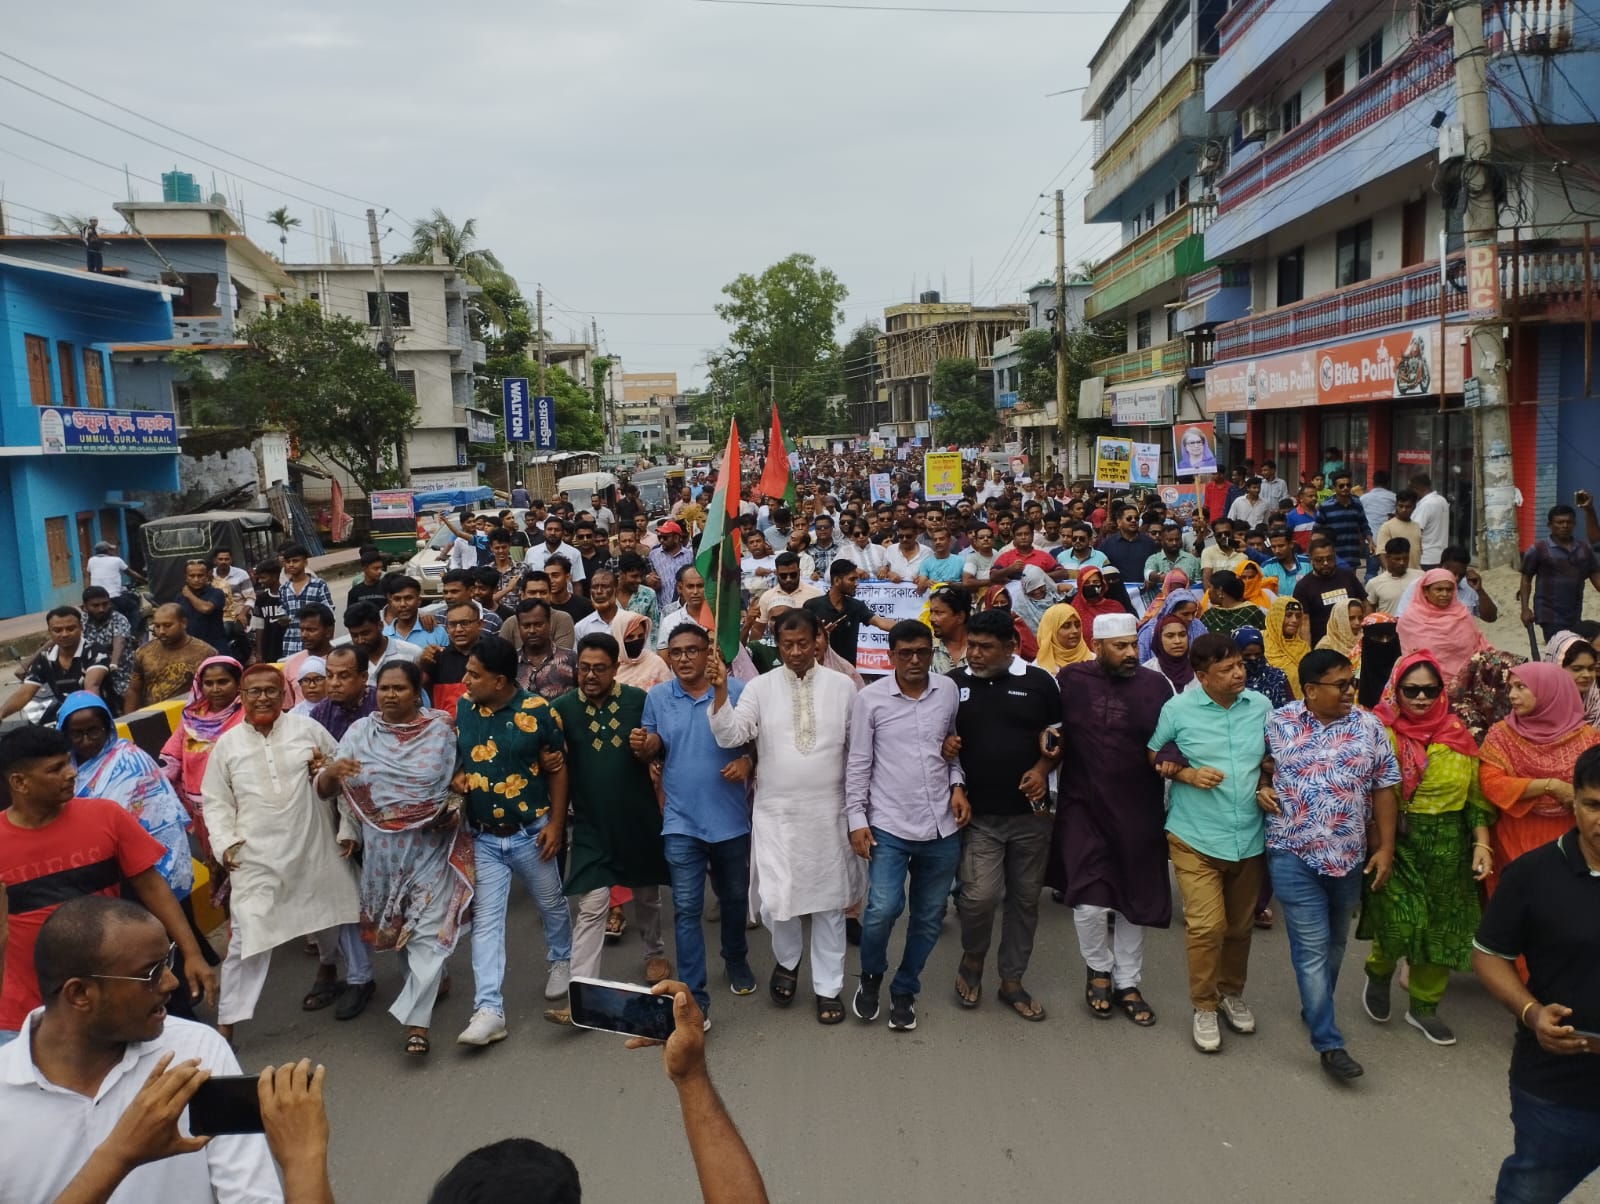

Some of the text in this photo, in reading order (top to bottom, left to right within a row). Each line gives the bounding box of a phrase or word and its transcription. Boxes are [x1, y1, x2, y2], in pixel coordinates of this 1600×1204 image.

[1471, 248, 1494, 308] DMC
[1270, 372, 1289, 393] Bike
[1289, 369, 1315, 391] Point
[1334, 361, 1359, 386] Bike
[1361, 355, 1396, 383] Point
[510, 381, 524, 438] WALTON
[80, 435, 110, 443] UMMUL
[143, 436, 171, 444] NARAIL
